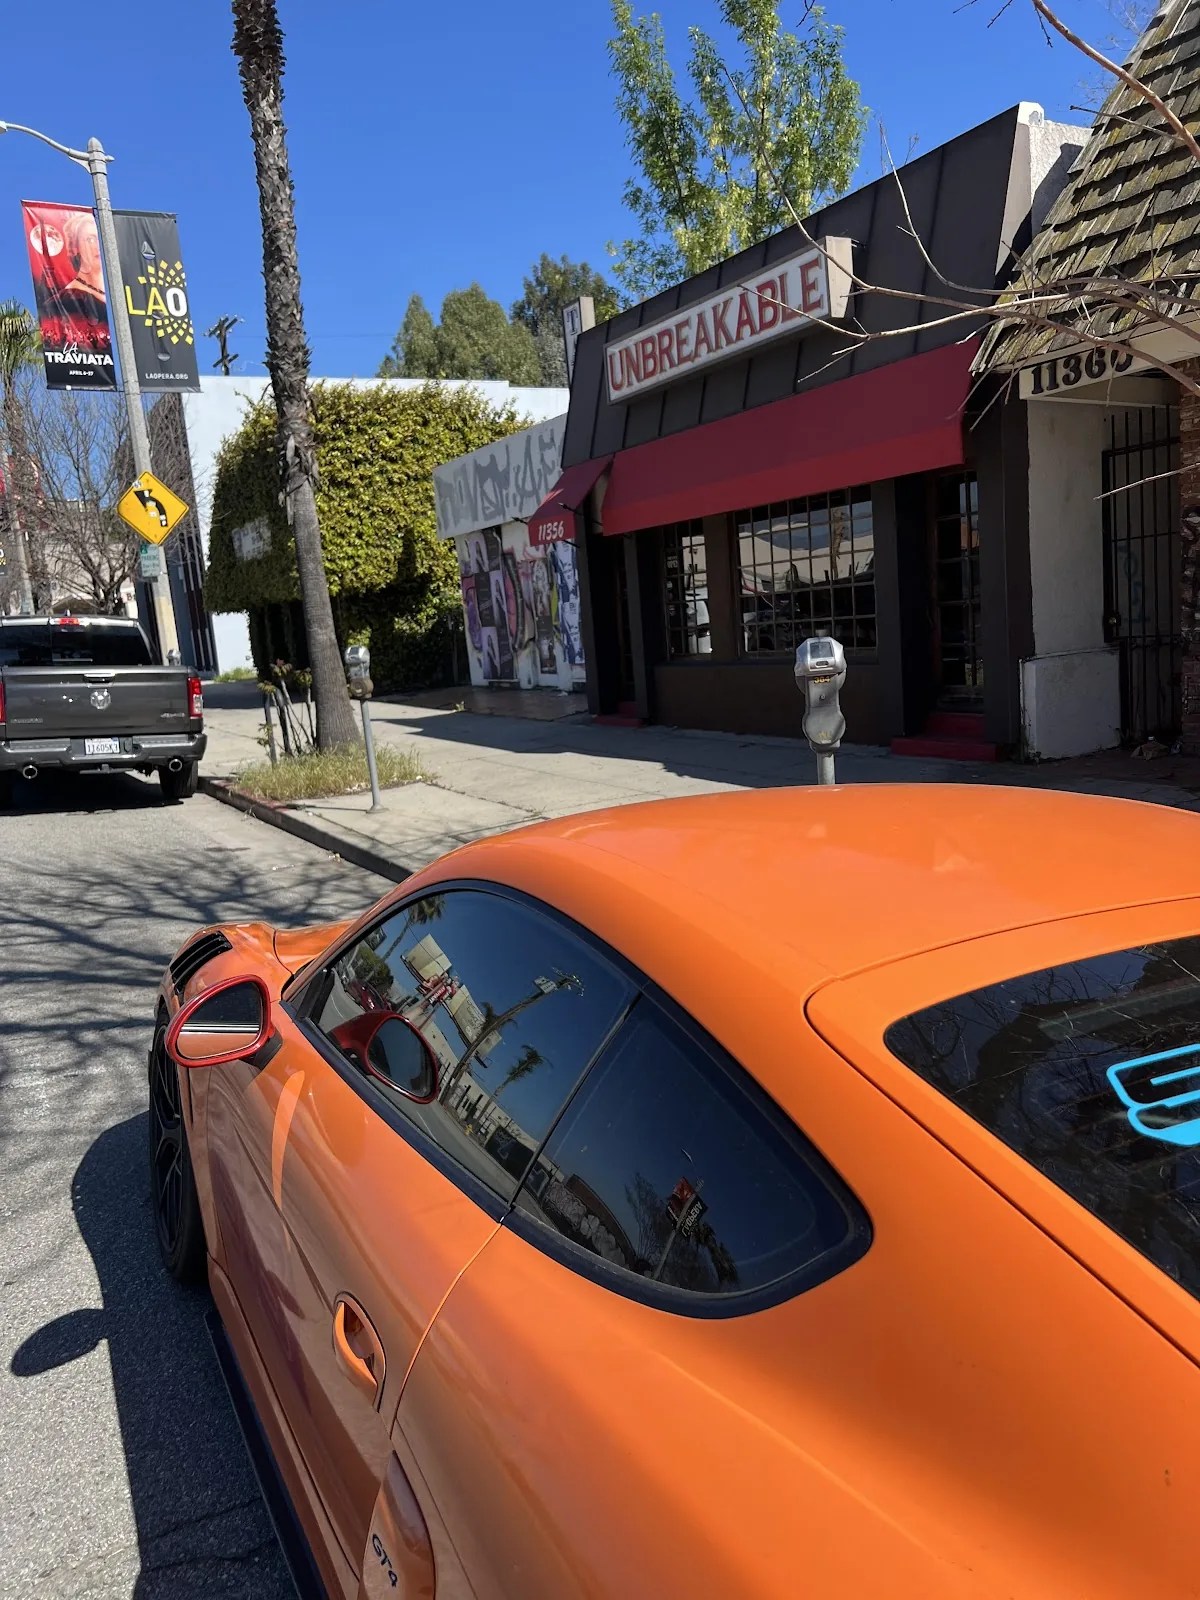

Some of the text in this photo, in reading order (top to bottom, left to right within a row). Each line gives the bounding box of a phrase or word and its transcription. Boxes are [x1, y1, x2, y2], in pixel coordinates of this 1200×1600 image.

[125, 285, 187, 317] LAO
[608, 257, 824, 392] UNBREAKABLE
[63, 341, 78, 354] LA
[44, 351, 114, 366] TRAVIATA
[145, 372, 189, 380] LAOPERA.ORG
[538, 520, 564, 541] 11356
[372, 1533, 398, 1588] GT4
